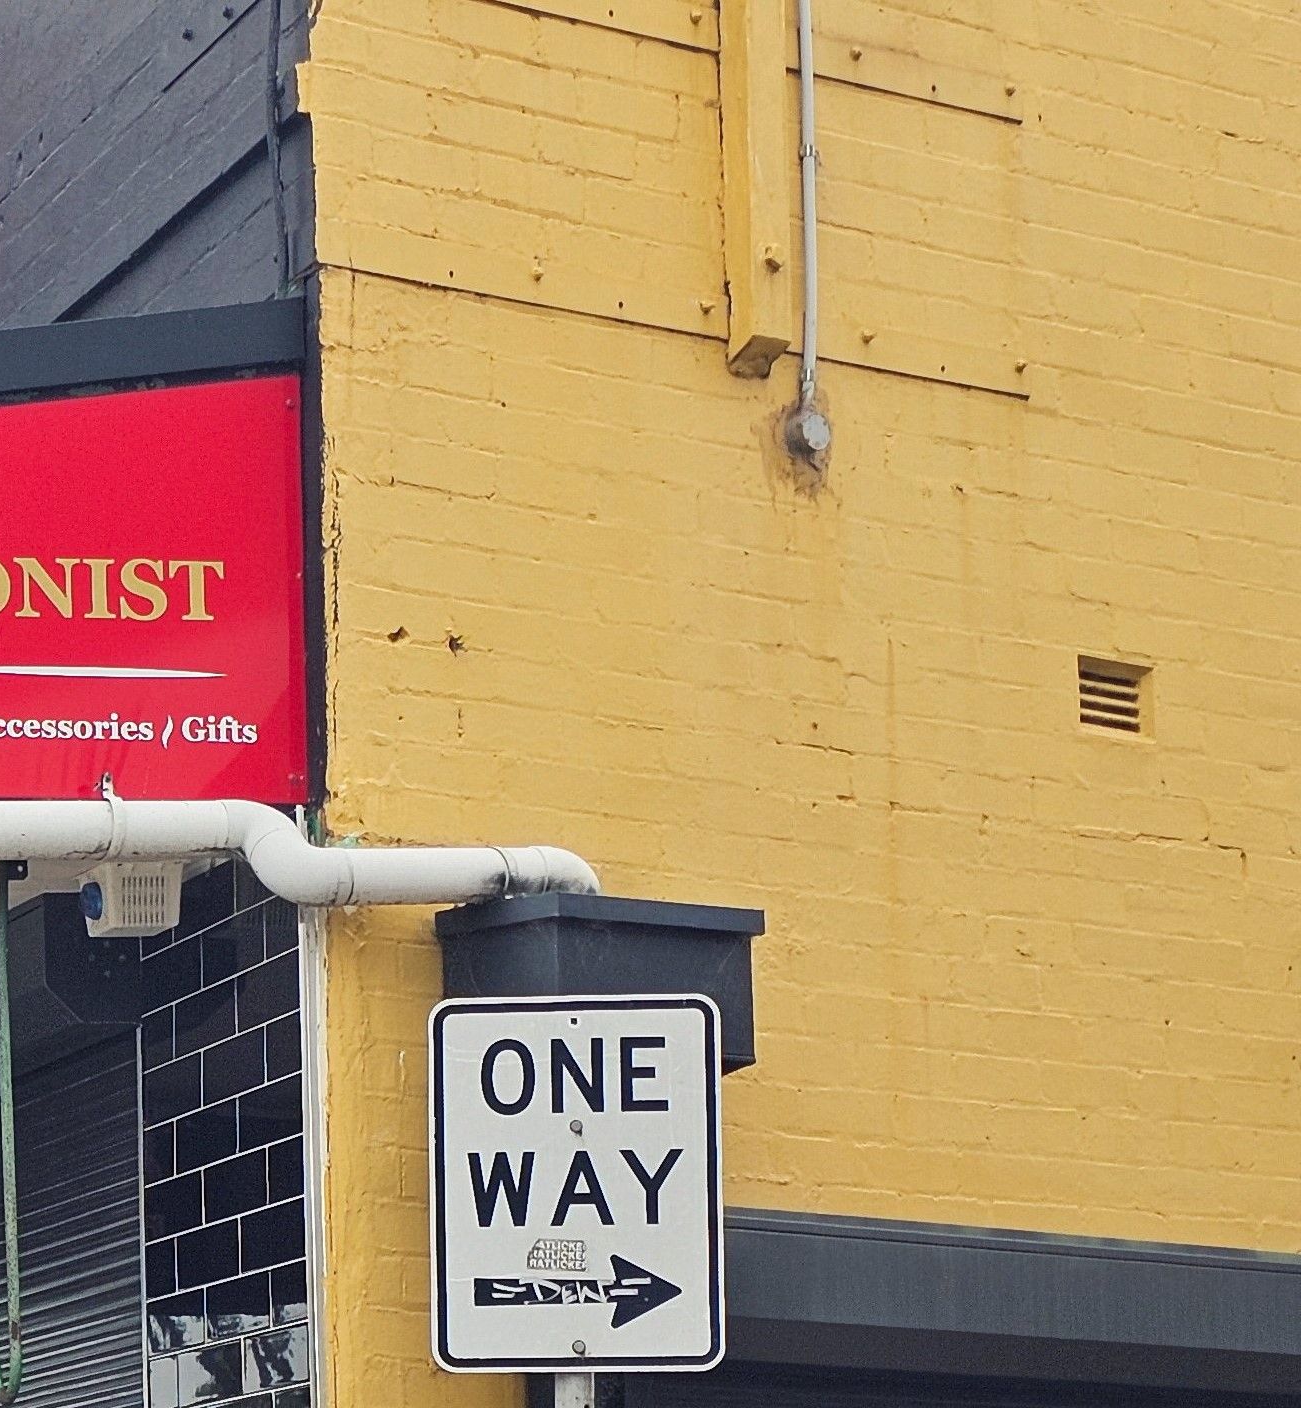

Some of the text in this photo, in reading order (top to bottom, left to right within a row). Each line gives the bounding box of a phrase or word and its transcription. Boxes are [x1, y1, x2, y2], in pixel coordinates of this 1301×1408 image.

[181, 716, 258, 744] Gifts
[480, 1036, 670, 1116] ONE
[468, 1148, 684, 1228] WAY
